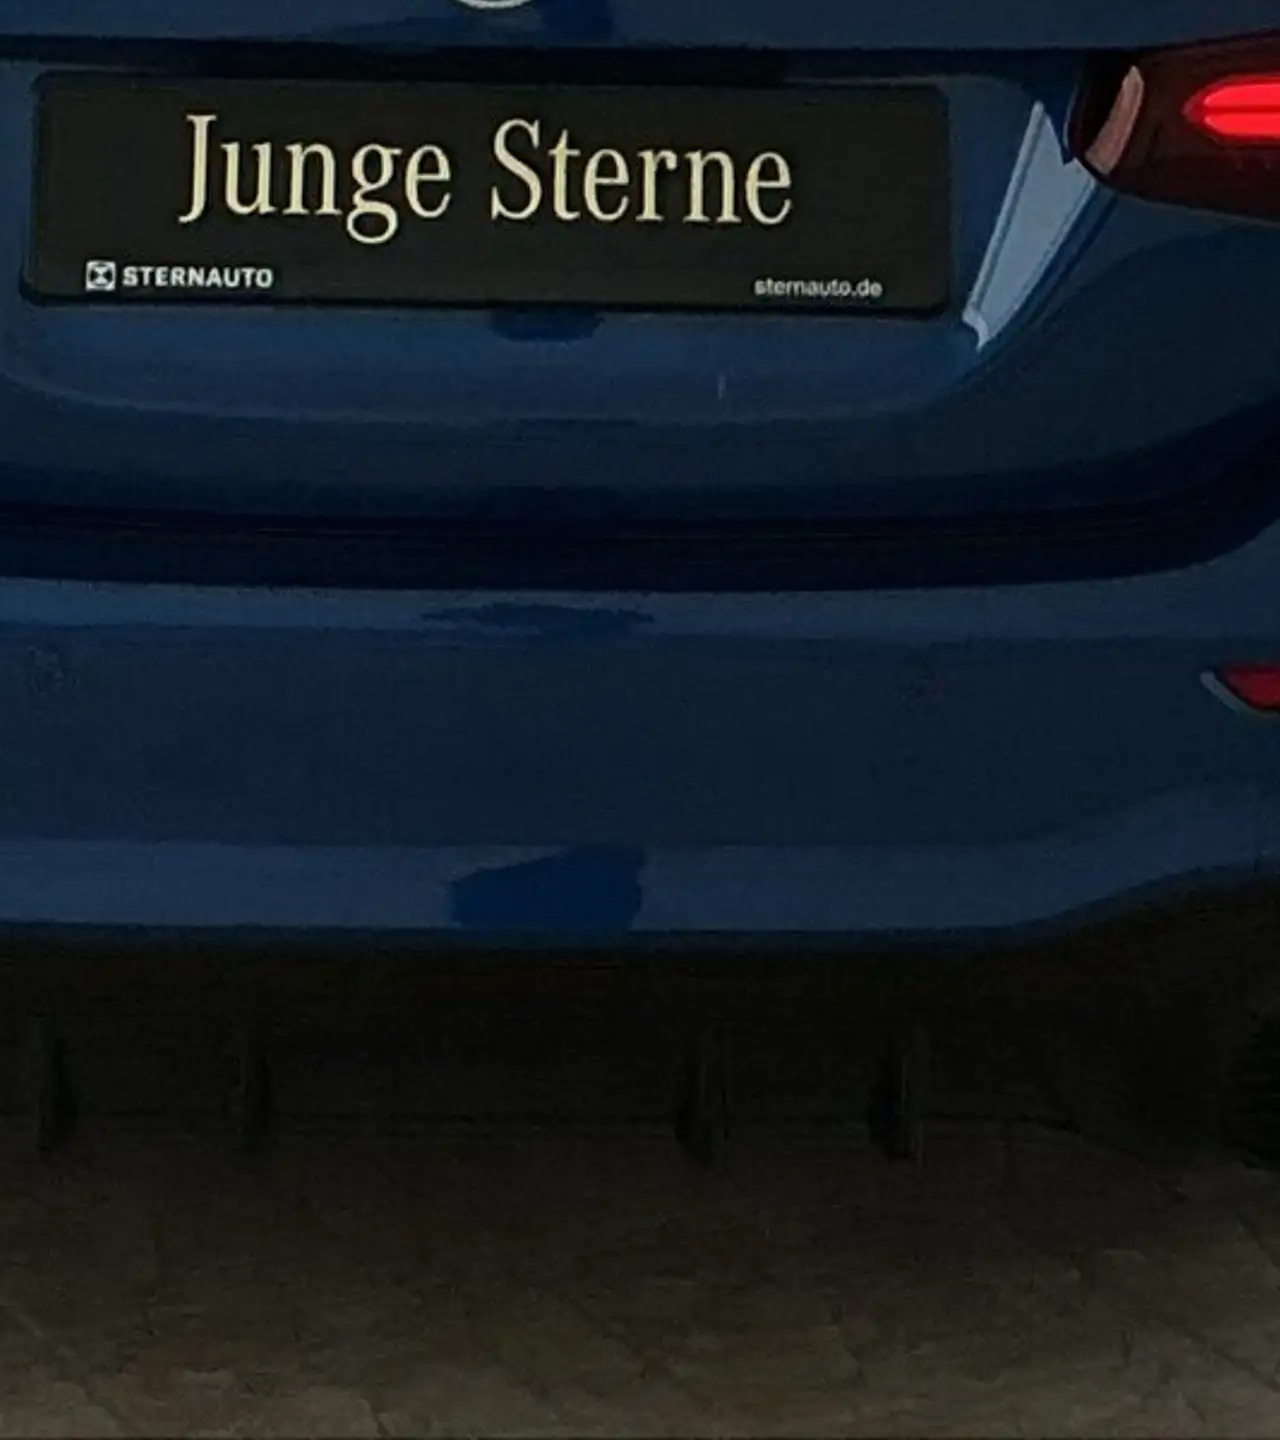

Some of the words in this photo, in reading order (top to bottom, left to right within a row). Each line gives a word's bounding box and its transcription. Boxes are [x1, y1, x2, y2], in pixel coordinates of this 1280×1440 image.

[178, 113, 453, 245] Junge
[490, 117, 794, 226] Sterne
[122, 265, 274, 288] STERNAUTO
[753, 277, 883, 298] sternauto.de
